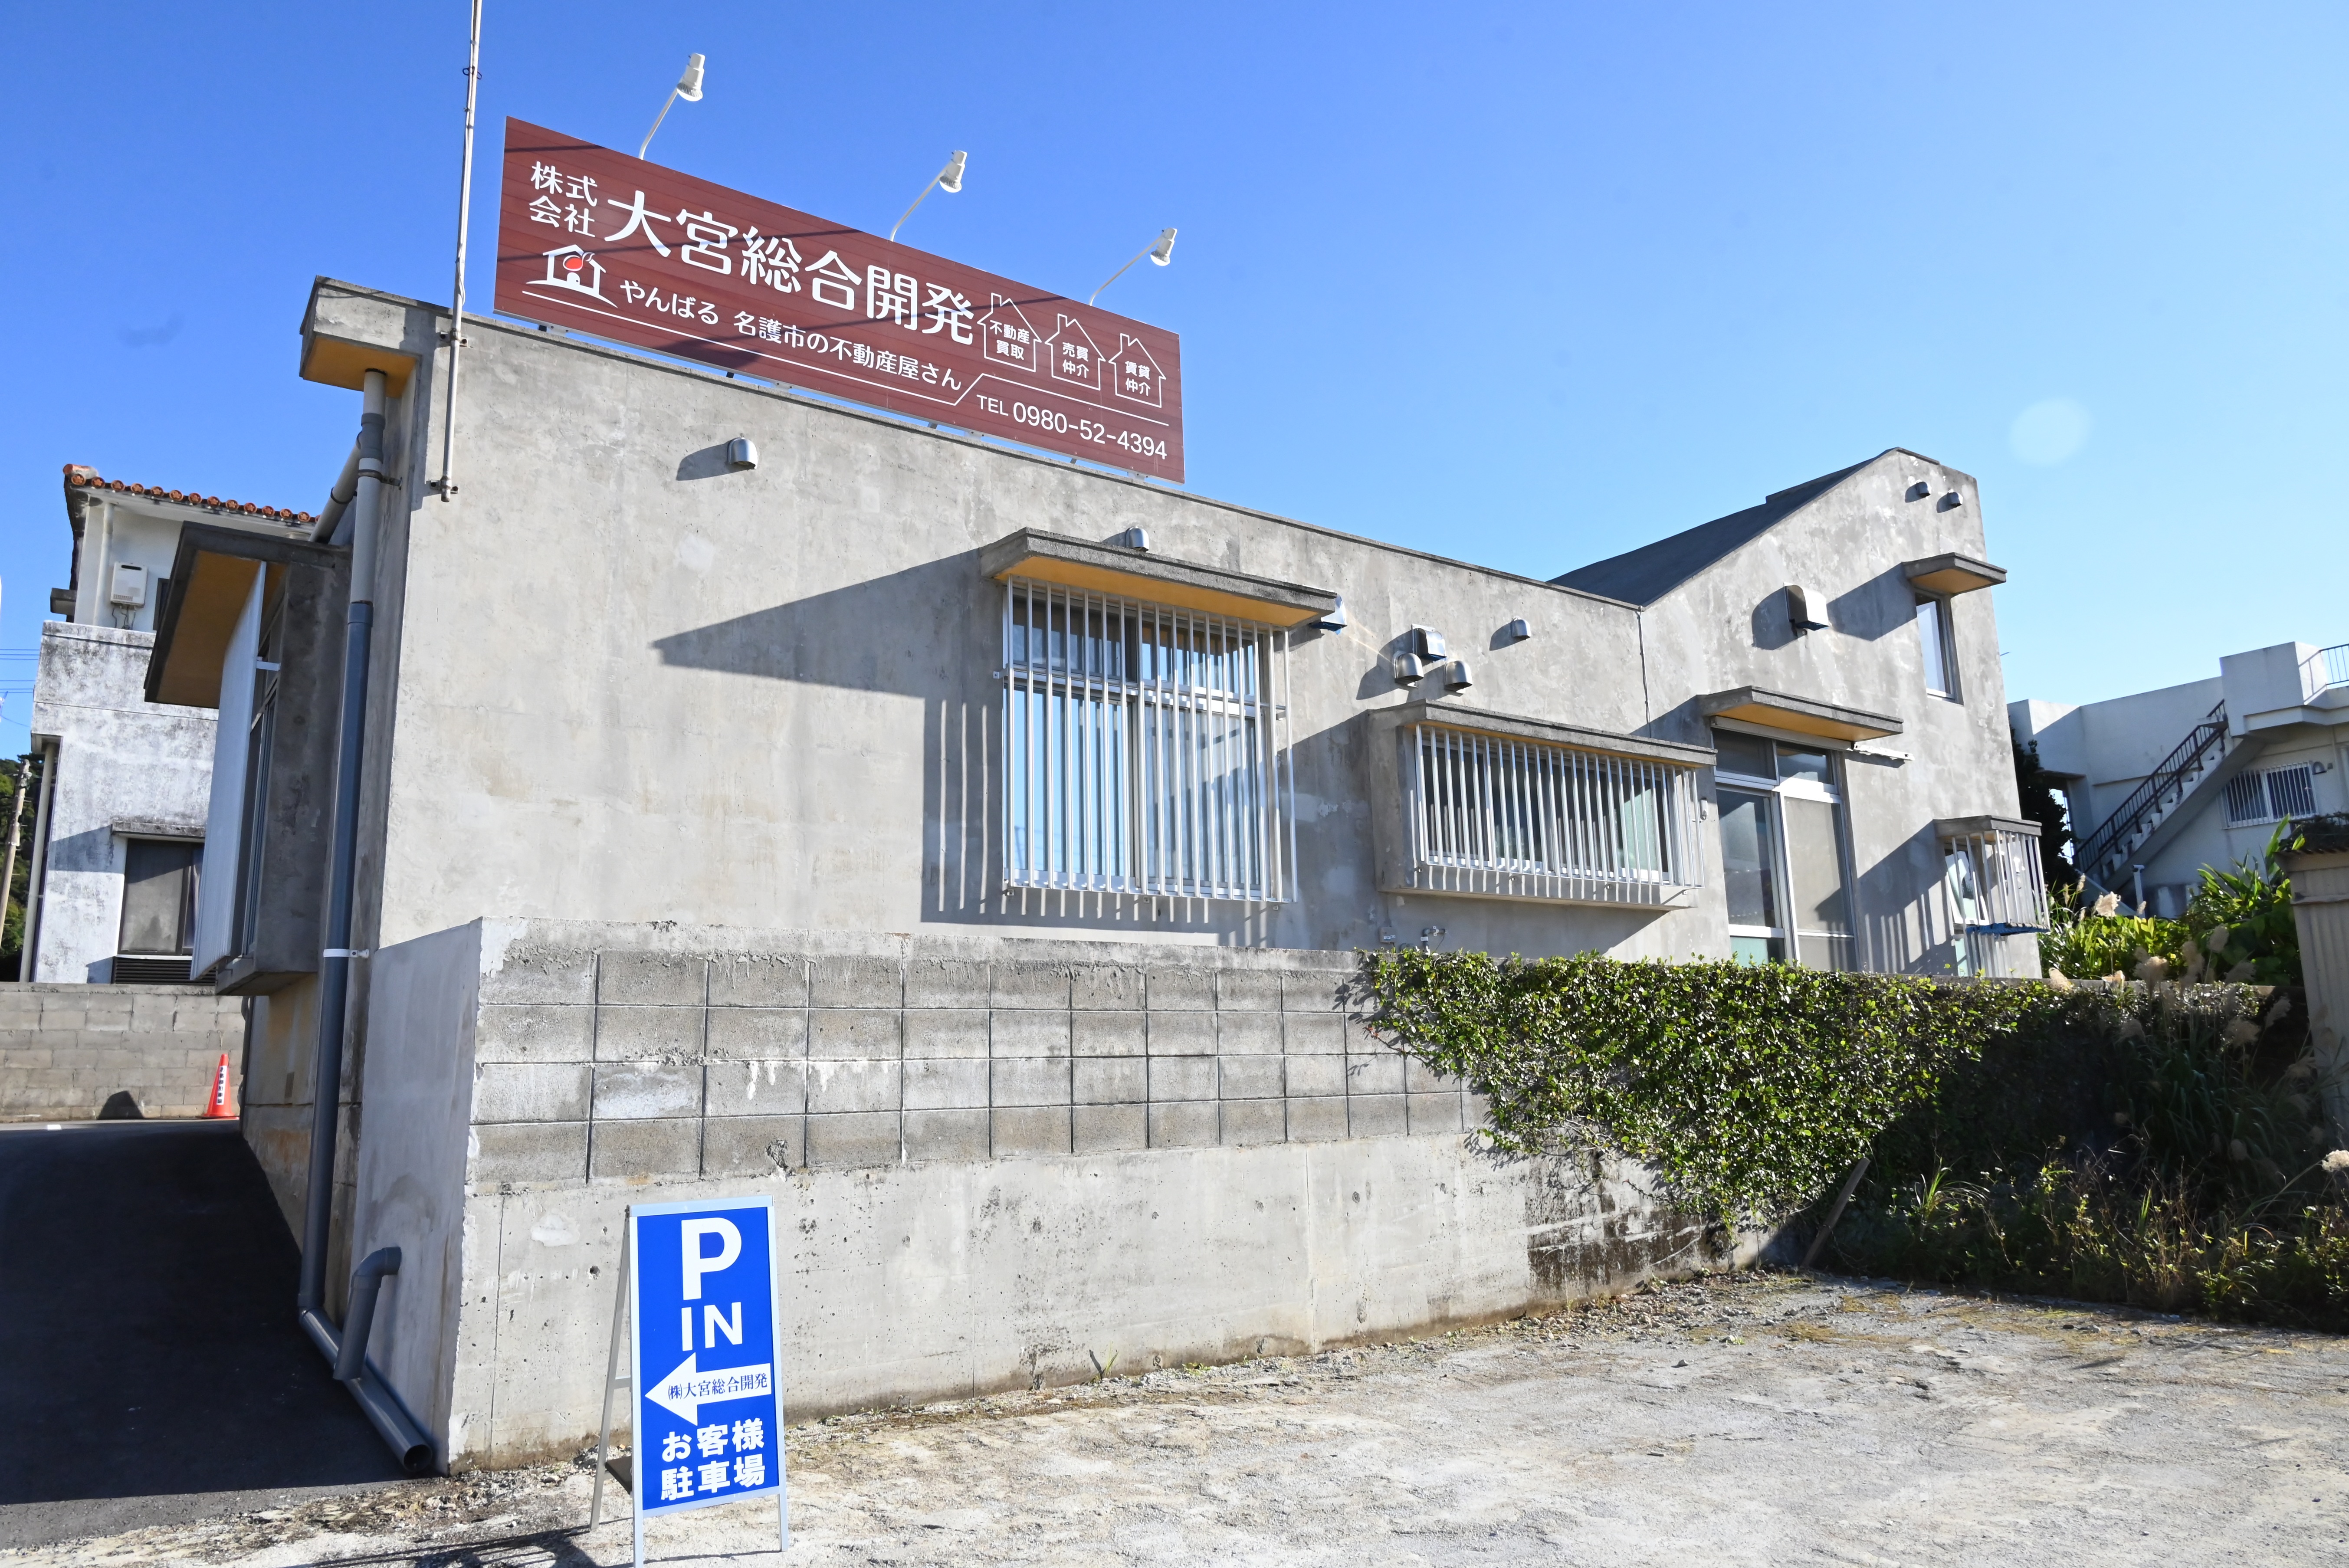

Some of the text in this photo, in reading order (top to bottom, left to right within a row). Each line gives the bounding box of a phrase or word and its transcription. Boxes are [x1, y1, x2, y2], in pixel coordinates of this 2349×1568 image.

[530, 161, 598, 207] 株式
[529, 195, 596, 238] 会社
[604, 190, 974, 345] 大宮総合開発
[620, 279, 962, 391] やんばる 名護市の不動産屋さん
[989, 319, 1030, 345] 不動産
[996, 339, 1024, 361] 買取
[1062, 342, 1089, 362] 売買
[1062, 359, 1089, 379] 仲介
[1125, 361, 1150, 380] 賃貸
[1125, 377, 1151, 397] 仲介
[976, 394, 1168, 460] TEL 0980-52-4394
[681, 1217, 742, 1301] P
[681, 1302, 743, 1352] IN
[662, 1417, 765, 1463] お客様
[660, 1453, 766, 1501] 駐車場
